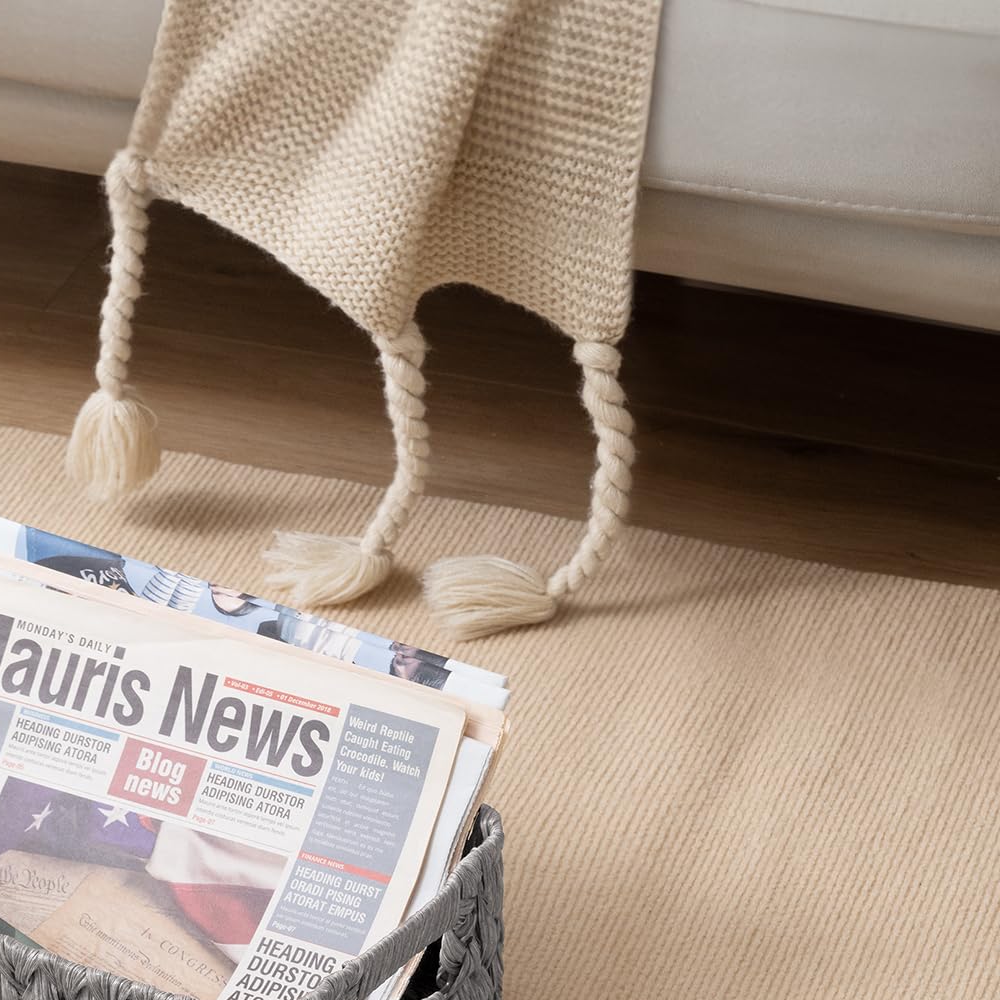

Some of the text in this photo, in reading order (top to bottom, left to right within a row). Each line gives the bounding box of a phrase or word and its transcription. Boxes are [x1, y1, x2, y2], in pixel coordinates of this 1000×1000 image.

[17, 619, 112, 654] MONDAY'S DAILY
[16, 717, 112, 753] HEADING DURSTOR
[158, 665, 330, 777] News
[349, 715, 415, 744] Weird Reptile
[11, 731, 62, 754] ADIPISING
[63, 745, 97, 765] ATORA
[340, 745, 421, 778] Crocodile. Watch
[344, 730, 412, 761] Caught Eating
[135, 747, 186, 786] Blog
[336, 759, 385, 783] Your kids!
[124, 773, 182, 806] news
[201, 786, 254, 809] ADIPISING
[255, 801, 291, 820] ATORA
[206, 772, 305, 809] HEADING DURSTOR
[301, 852, 345, 870] FINANCE NEWS
[19, 868, 70, 894] People
[290, 878, 362, 908] ORADI PISING
[295, 865, 383, 899] HEADING DURST
[283, 891, 328, 912] ATORAT
[328, 903, 367, 924] EMPUS
[256, 936, 337, 974] HEADING
